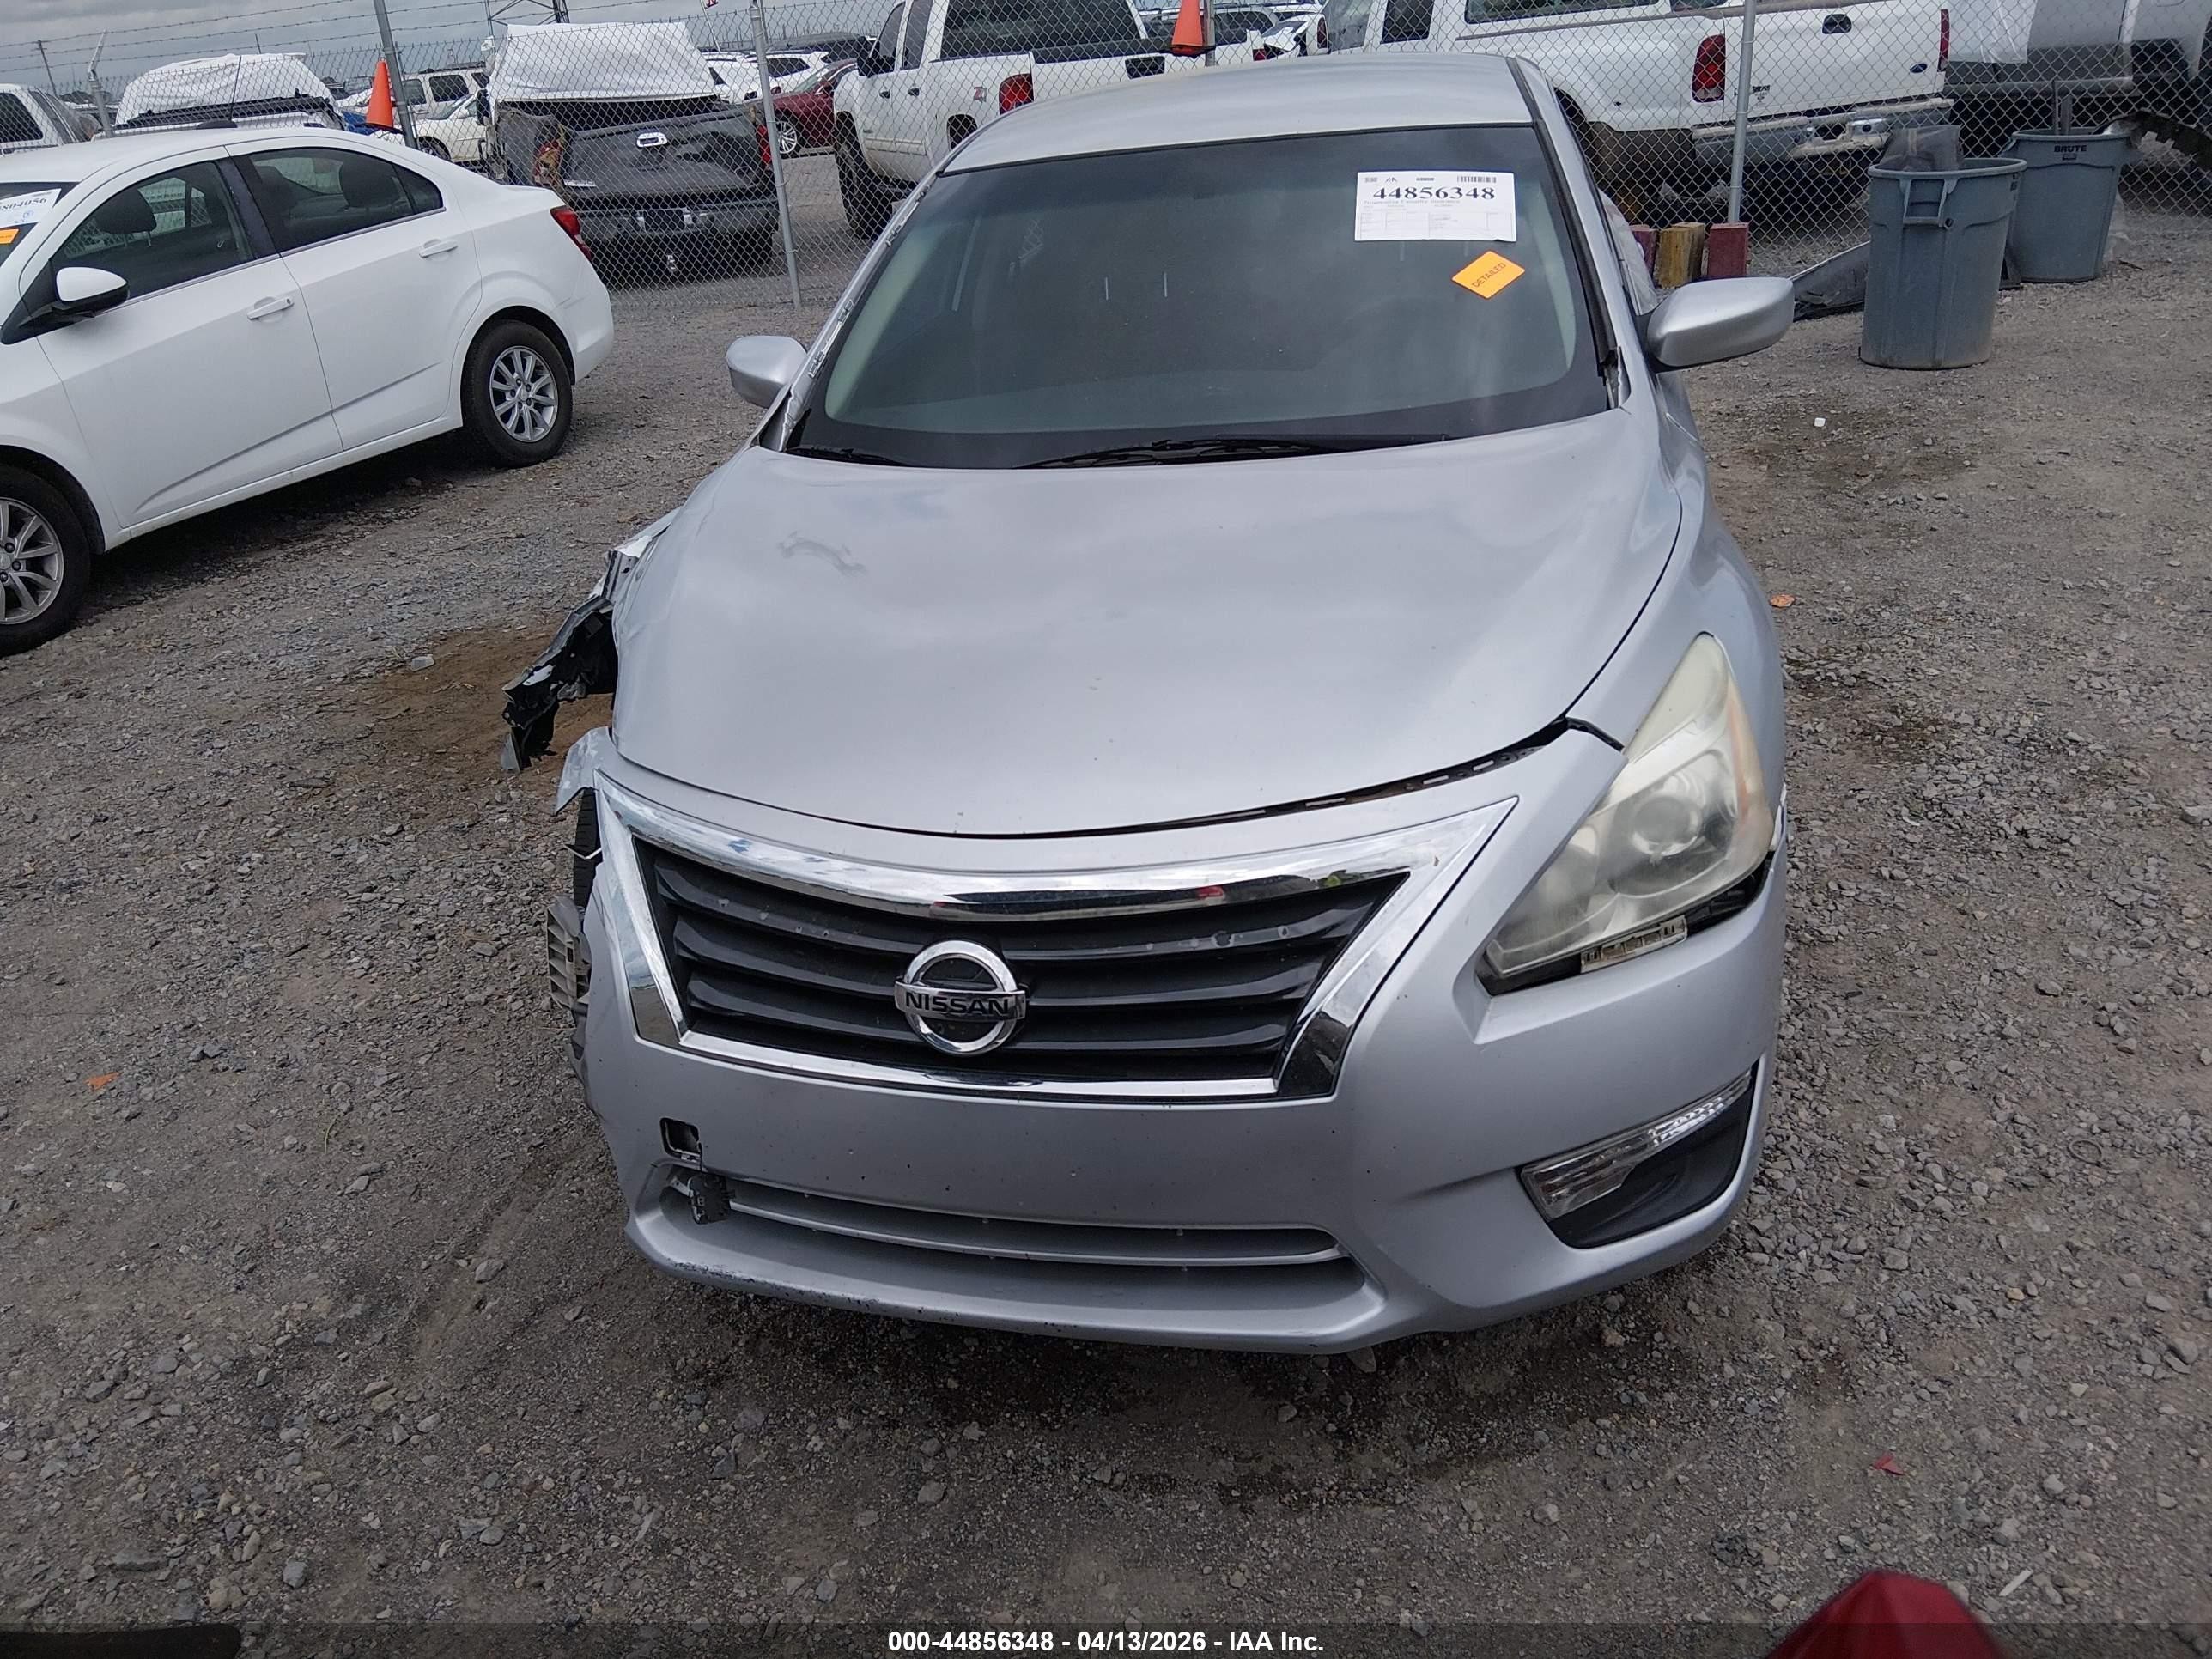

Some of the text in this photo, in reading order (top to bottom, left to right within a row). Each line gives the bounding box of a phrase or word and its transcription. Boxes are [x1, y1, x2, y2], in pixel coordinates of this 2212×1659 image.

[2053, 144, 2087, 153] BRUTE
[1373, 186, 1496, 200] 44856348
[0, 197, 48, 212] 804056
[1471, 262, 1507, 289] DETAILED
[905, 991, 1009, 1016] NISSAN
